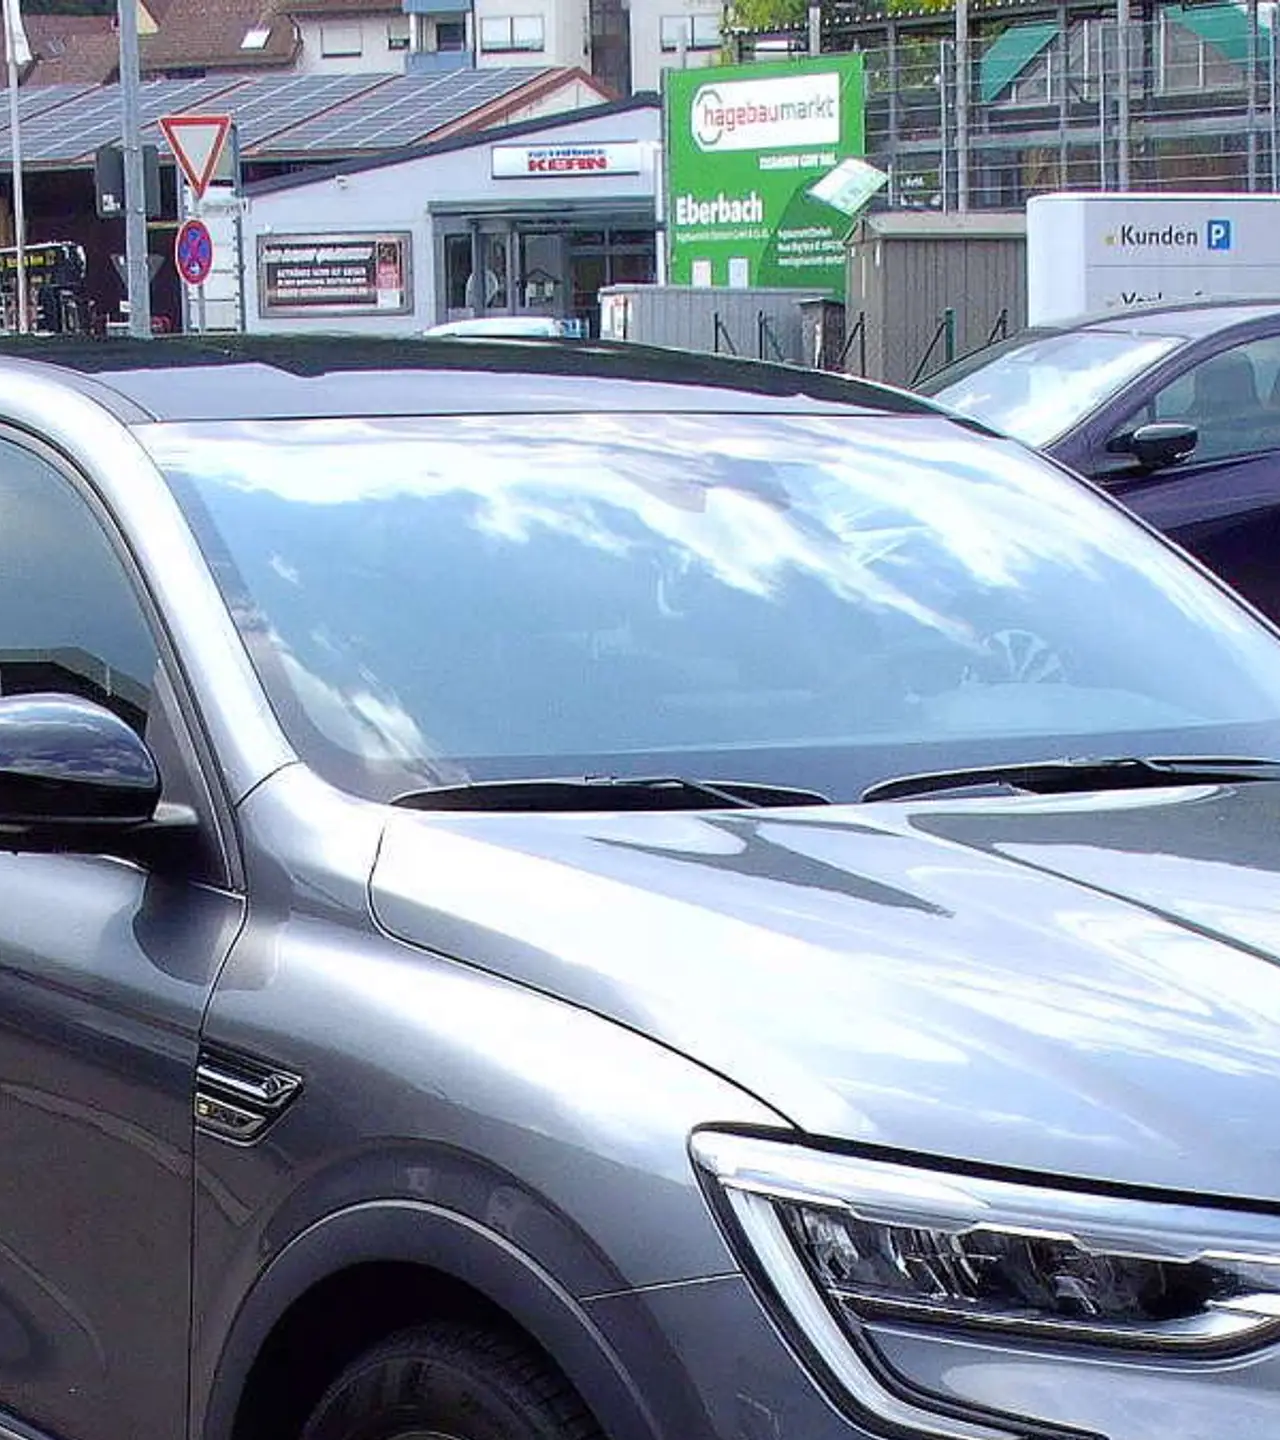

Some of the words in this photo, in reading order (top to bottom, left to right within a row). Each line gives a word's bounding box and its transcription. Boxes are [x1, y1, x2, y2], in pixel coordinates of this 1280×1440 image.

[703, 95, 835, 132] hagebaumarkt
[676, 190, 763, 225] Eberbach
[1121, 225, 1199, 248] Kunden
[1209, 222, 1228, 248] P
